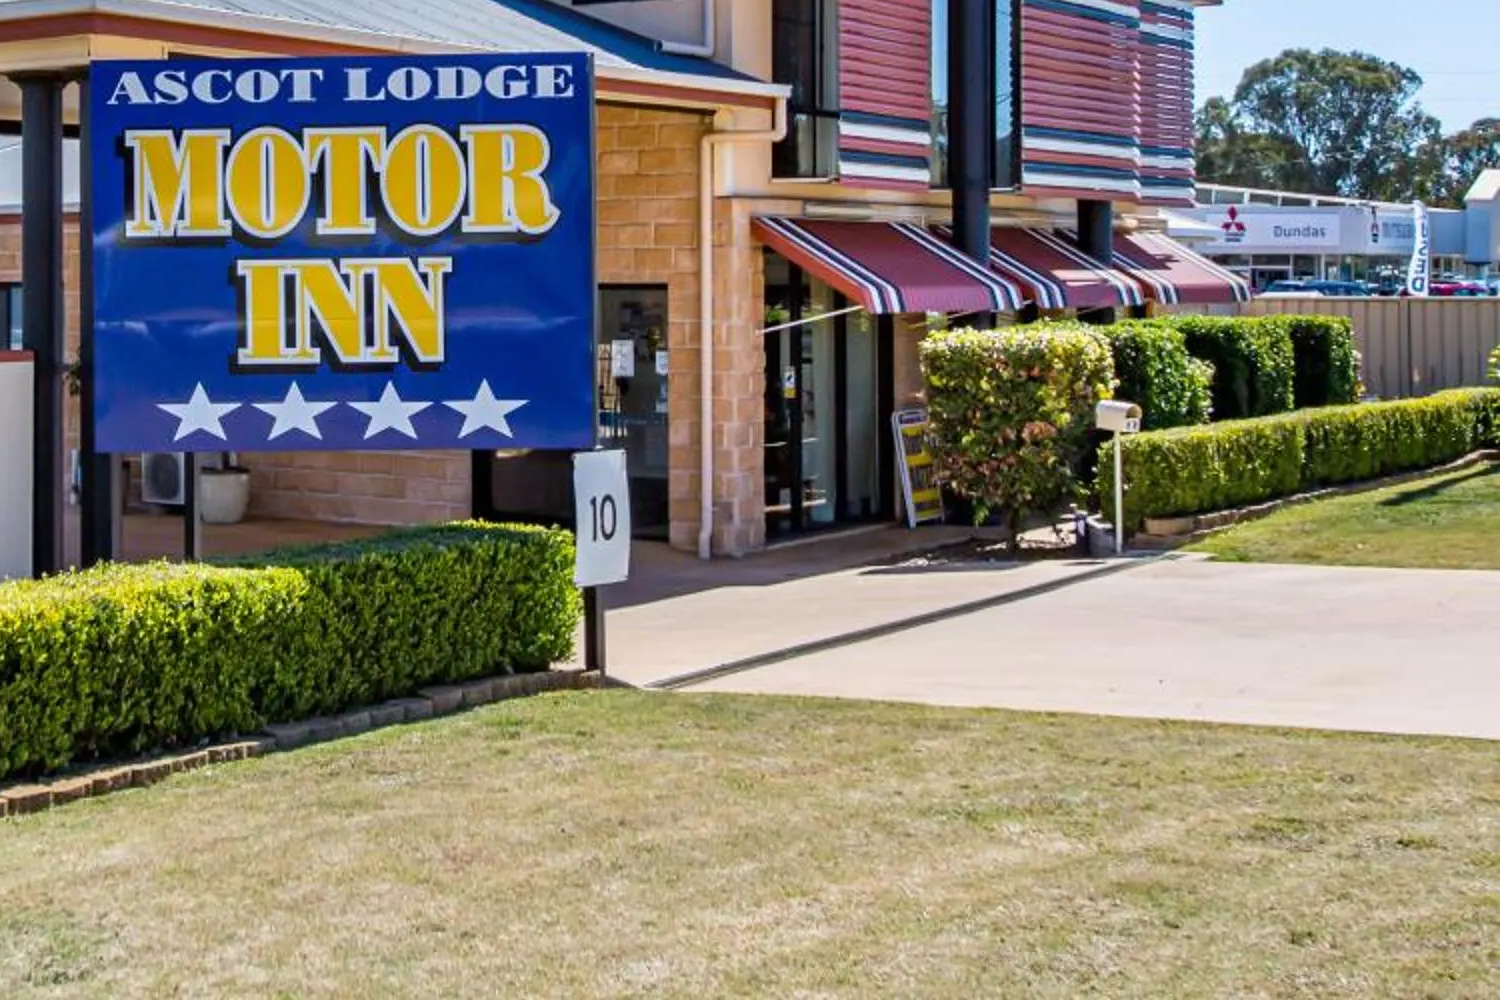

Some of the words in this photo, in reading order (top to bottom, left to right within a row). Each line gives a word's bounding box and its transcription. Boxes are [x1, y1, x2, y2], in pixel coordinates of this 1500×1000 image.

[107, 69, 324, 105] ASCOT
[344, 65, 575, 102] LODGE
[124, 123, 561, 239] MOTOR
[1273, 225, 1326, 239] Dundas
[237, 256, 453, 365] INN
[590, 494, 617, 542] 10
